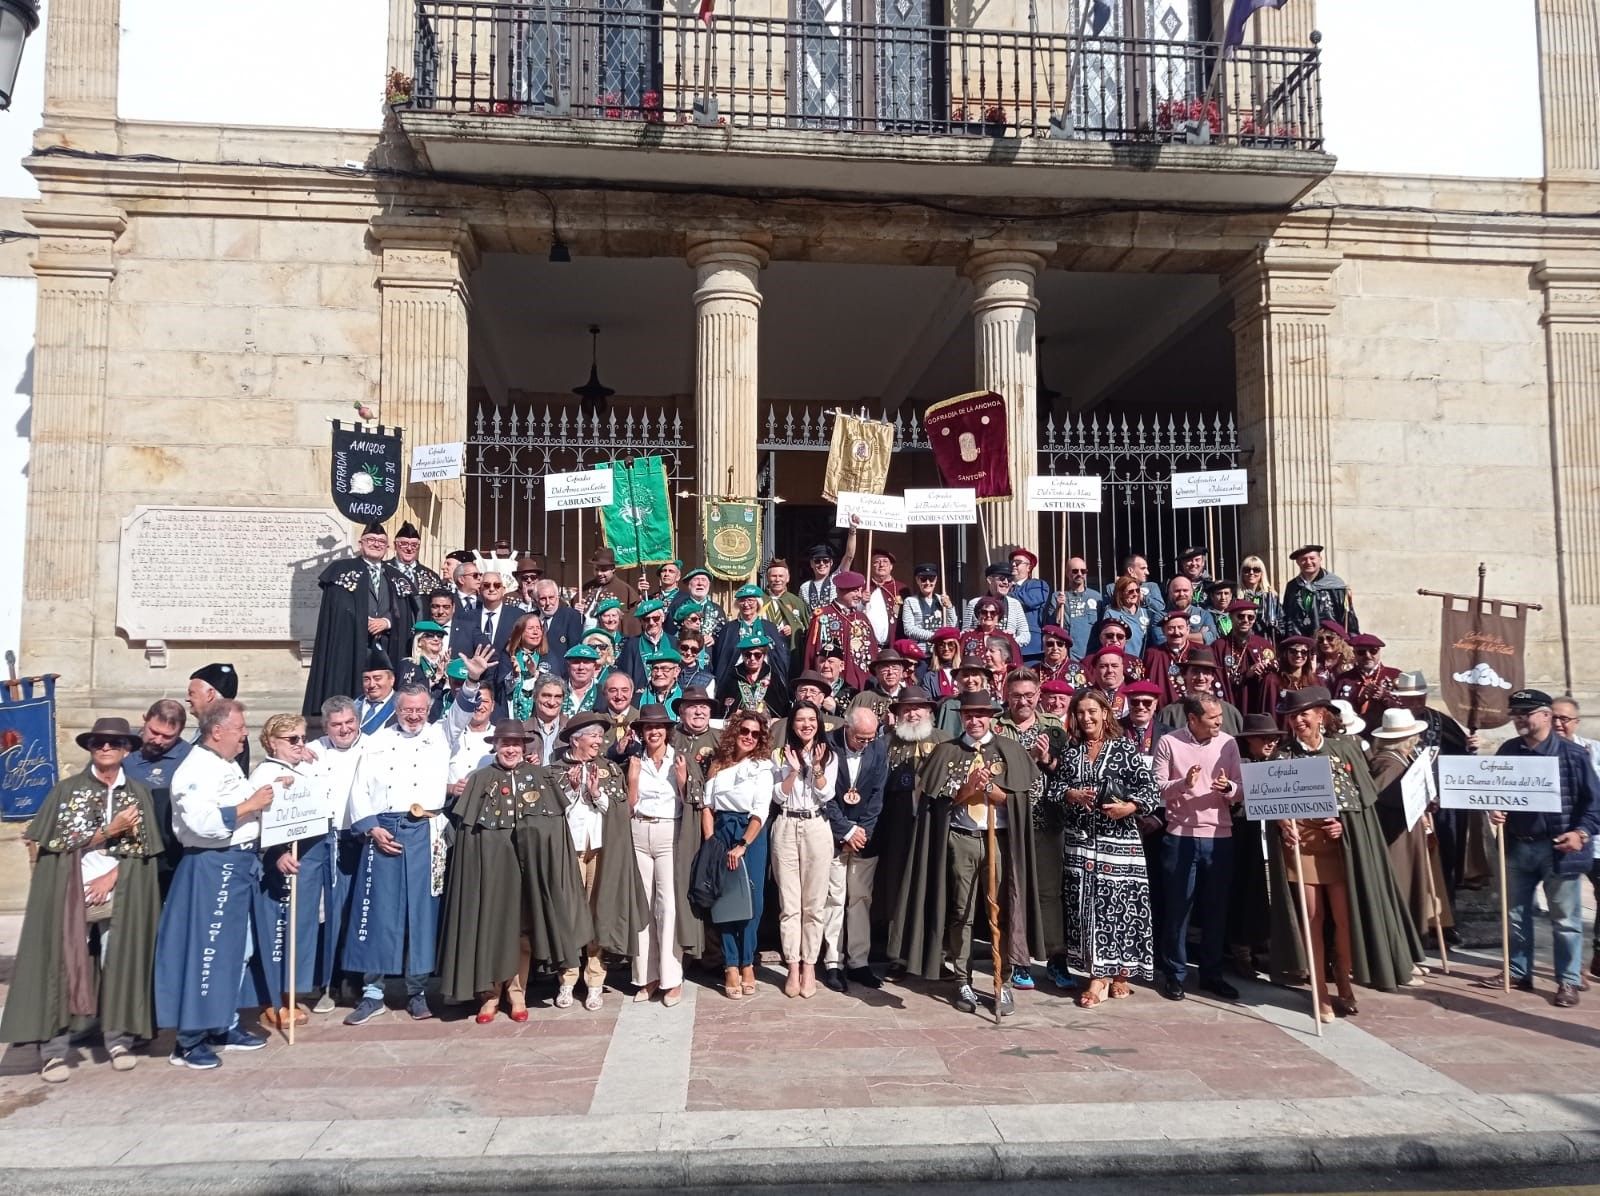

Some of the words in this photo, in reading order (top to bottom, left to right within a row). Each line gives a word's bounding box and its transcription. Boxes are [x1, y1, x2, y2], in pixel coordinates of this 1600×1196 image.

[975, 400, 1002, 411] ANCHOA
[350, 440, 386, 455] AMIGOS
[335, 451, 347, 493] COFRADÍA
[385, 461, 396, 474] DE
[958, 471, 987, 481] SANTOÑA
[557, 496, 602, 506] CABRANES
[349, 502, 383, 516] NABOS
[1445, 774, 1456, 785] De
[1458, 775, 1465, 785] la
[1466, 775, 1490, 786] Buena
[1492, 776, 1517, 786] Mesa
[1518, 776, 1530, 786] del
[1532, 777, 1554, 788] Mar
[1250, 784, 1260, 794] del
[1260, 782, 1282, 796] Queso
[1283, 782, 1291, 792] de
[1469, 794, 1529, 806] SALINAS
[276, 808, 289, 822] Del
[1248, 804, 1278, 816] CANGAS
[1279, 803, 1290, 814] DE
[1291, 801, 1334, 814] ONIS-ONIS
[358, 898, 370, 942] Desarme
[209, 922, 222, 942] del
[201, 948, 216, 996] Desarme
